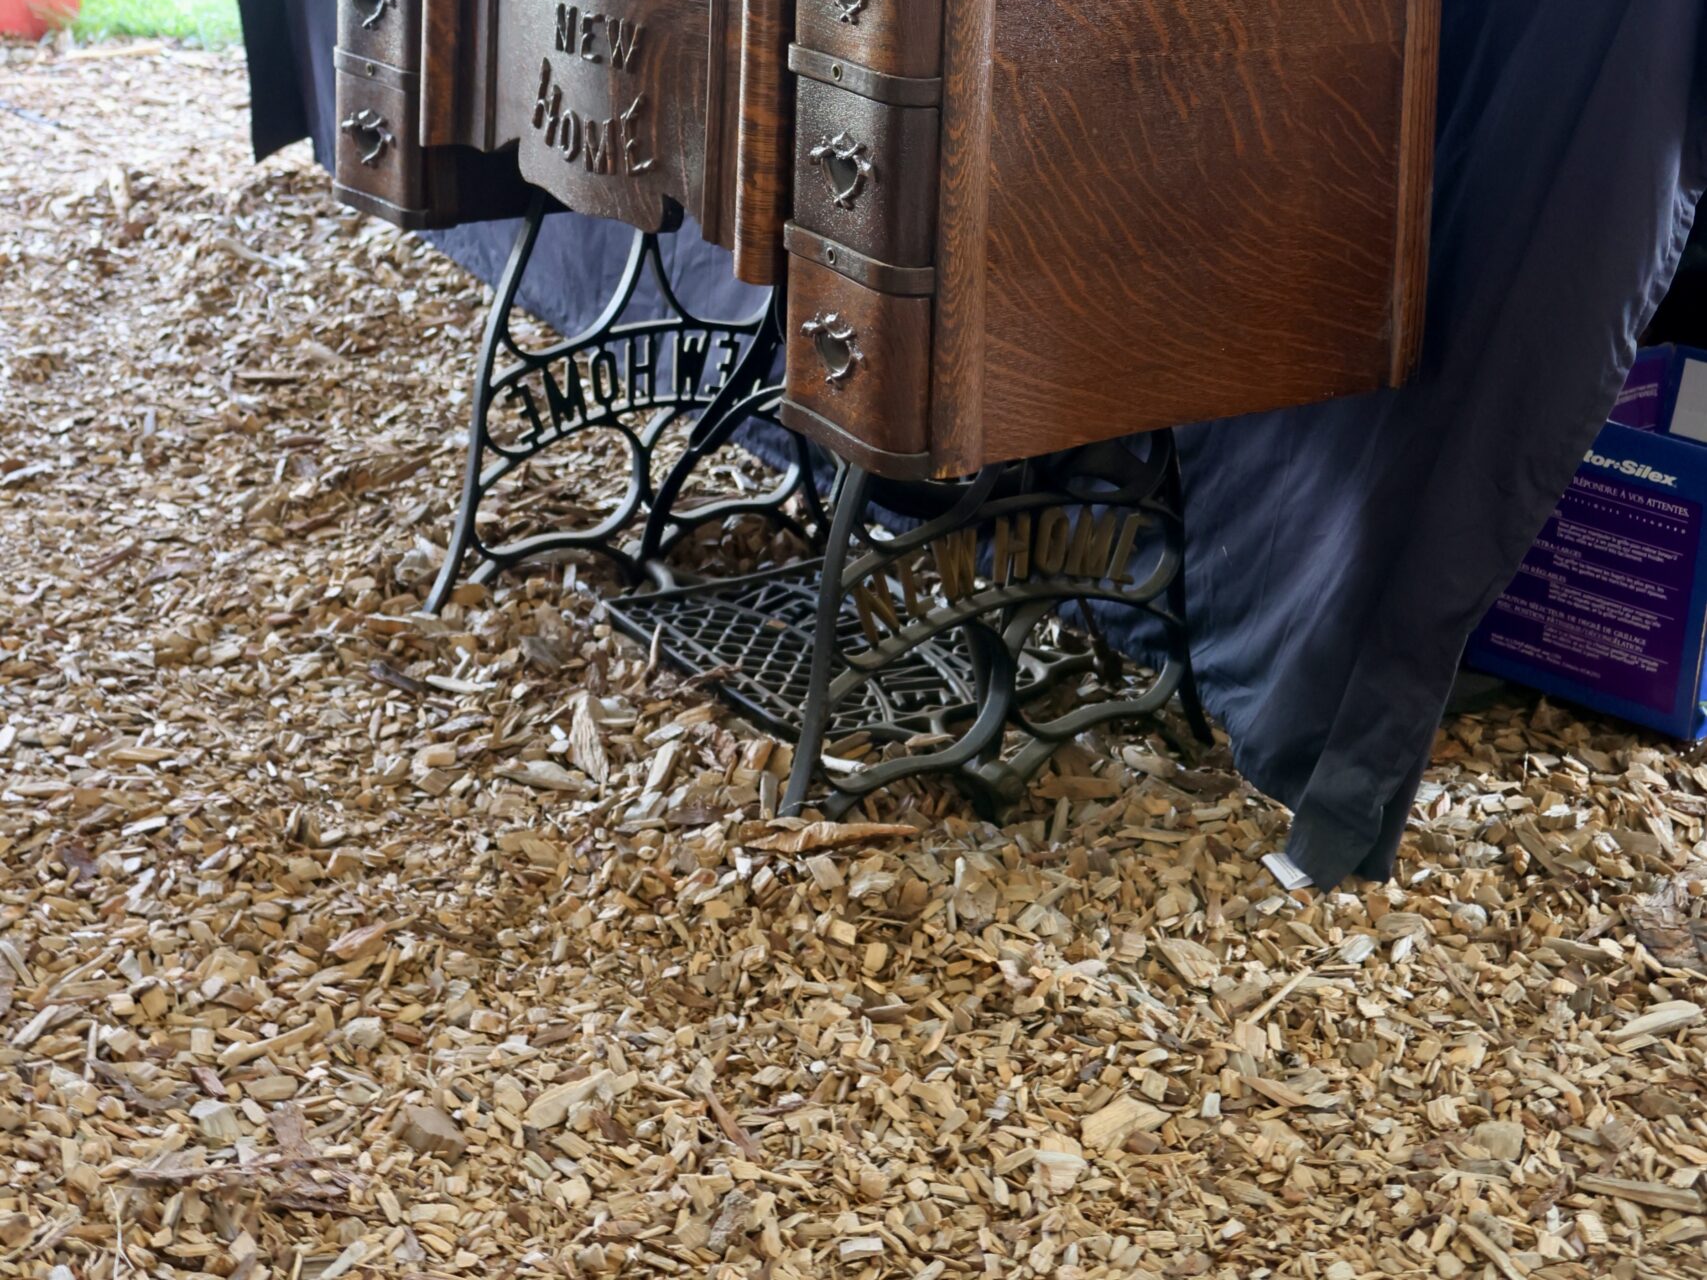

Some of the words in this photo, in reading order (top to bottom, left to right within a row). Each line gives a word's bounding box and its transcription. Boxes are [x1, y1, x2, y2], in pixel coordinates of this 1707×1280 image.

[556, 3, 646, 73] NEW
[532, 57, 654, 176] HOME
[1628, 492, 1645, 505] VOS
[854, 526, 977, 649] NEW
[993, 504, 1152, 587] HOME
